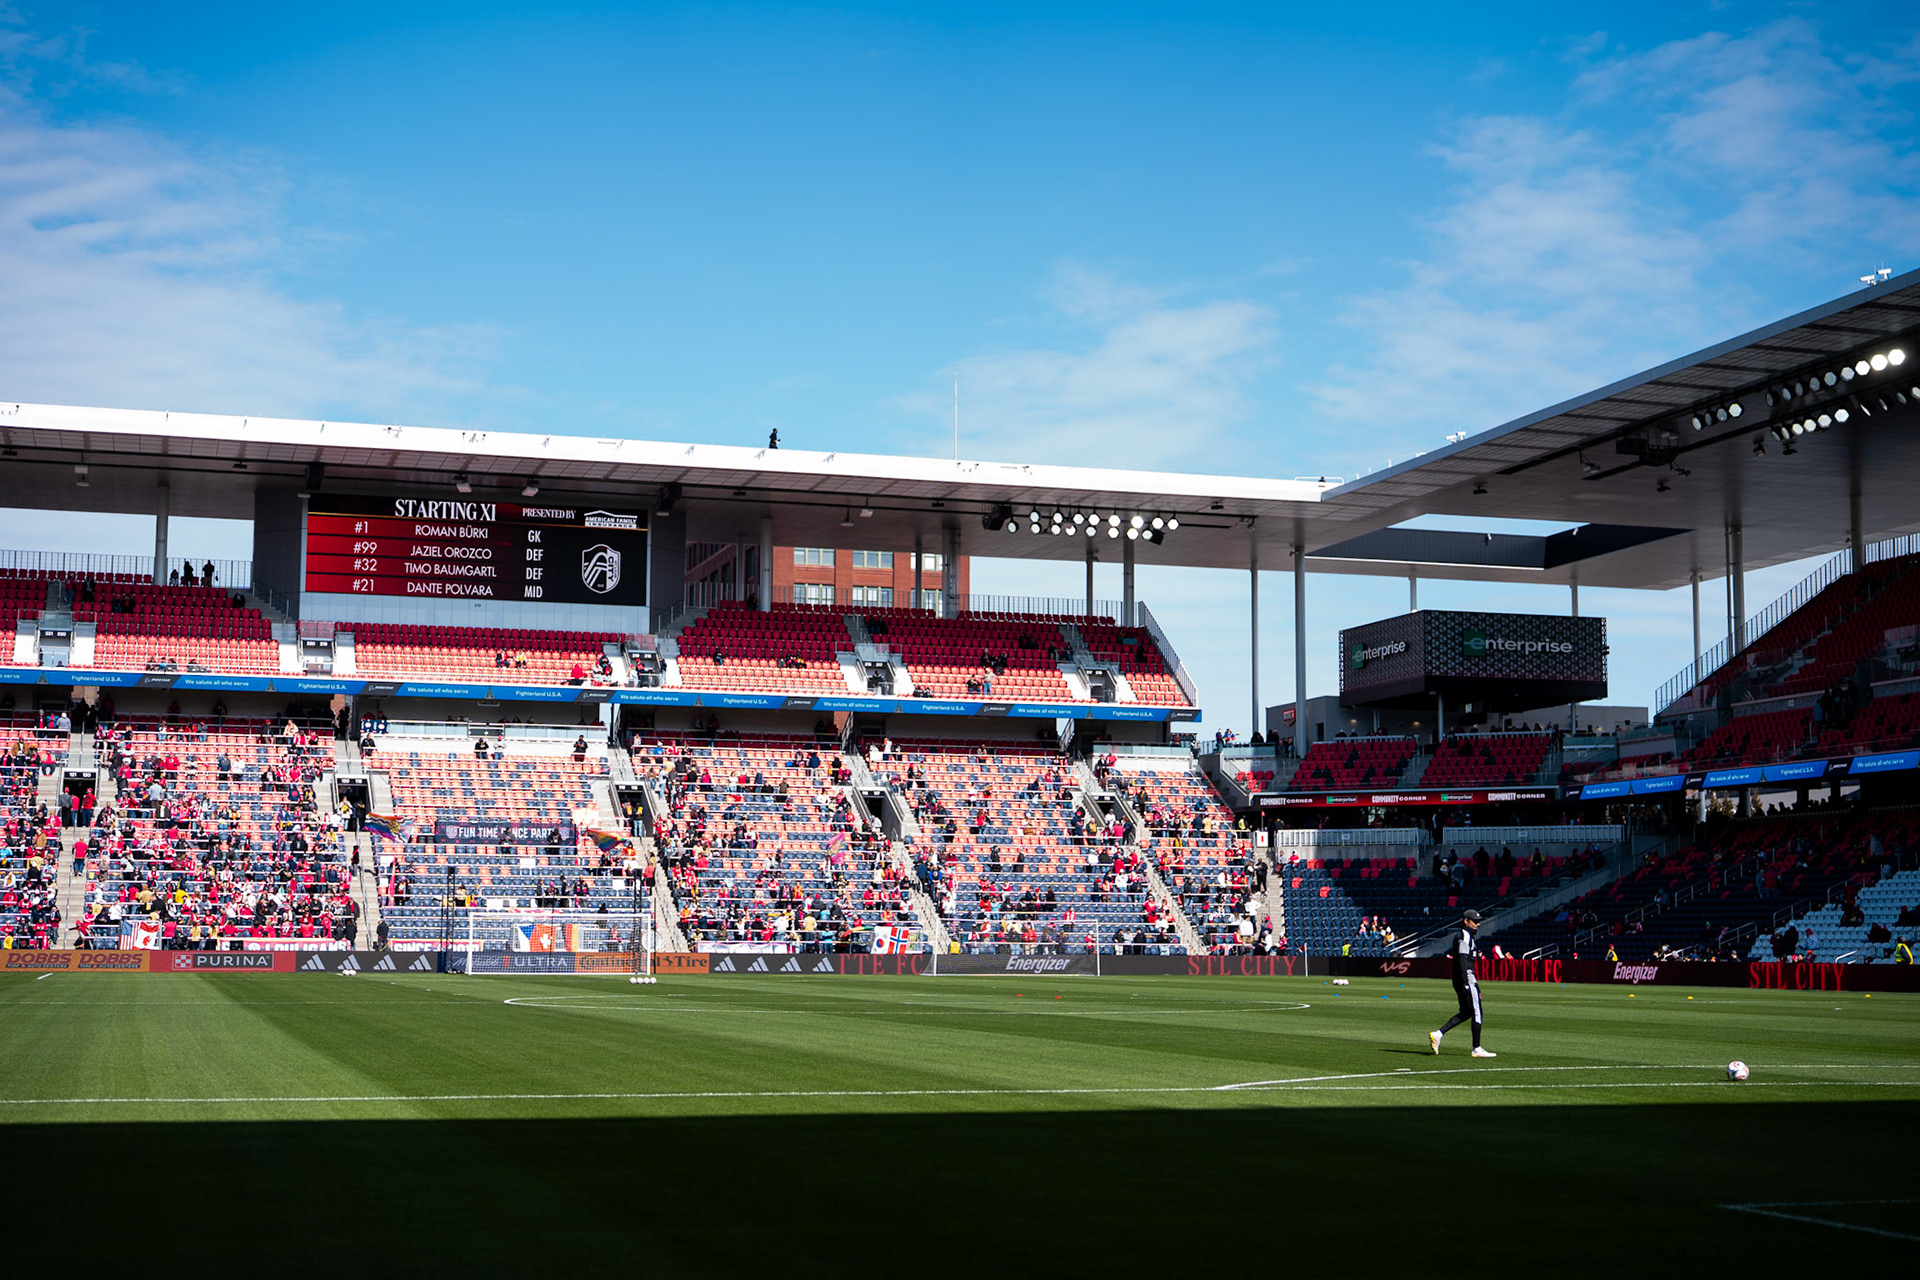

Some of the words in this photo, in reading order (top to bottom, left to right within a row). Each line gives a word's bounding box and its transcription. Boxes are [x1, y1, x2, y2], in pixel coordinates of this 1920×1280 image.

[395, 499, 477, 521] STARTING
[480, 504, 497, 522] XI
[522, 508, 565, 520] PRESENTED
[565, 510, 576, 521] BY
[354, 521, 369, 534] #1
[415, 524, 457, 537] ROMAN
[459, 525, 488, 540] BÜRKI
[527, 530, 541, 543] GK
[353, 541, 377, 554] #99
[410, 545, 442, 558] JAZIEL
[444, 547, 492, 560] OROZCO
[526, 549, 543, 562] DEF
[353, 558, 377, 571] #32
[404, 562, 431, 575] TIMO
[434, 564, 497, 578] BAUMGARTL
[526, 567, 543, 581] DEF
[352, 579, 374, 592] #21
[407, 582, 442, 595] DANTE
[445, 583, 494, 597] POLVARA
[524, 586, 543, 599] MID
[1353, 639, 1406, 663] enterprise
[1464, 637, 1572, 654] enterprise
[515, 690, 545, 698] Fighterland
[723, 697, 752, 705] Fighterland
[1260, 798, 1286, 806] COMMUNITY
[1372, 795, 1399, 803] COMMUNITY
[1488, 793, 1516, 801] COMMUNITY
[458, 827, 476, 839] FUN
[476, 826, 498, 839] TIME
[500, 827, 528, 838] DNCE
[530, 827, 556, 838] PART
[393, 942, 433, 951] SINCE
[7, 953, 72, 964] DOBBS
[79, 953, 143, 964] DOBBS
[515, 957, 568, 967] ULTRA
[674, 956, 708, 967] Tire
[896, 953, 923, 975] FC
[1005, 955, 1070, 973] Energizer
[1187, 955, 1231, 976] STL
[1240, 955, 1297, 976] CITY
[1474, 958, 1538, 982] ARLOTTE
[1545, 959, 1562, 983] FC
[1613, 961, 1659, 984] Energizer
[1750, 962, 1788, 989] STL
[1795, 962, 1845, 991] CITY
